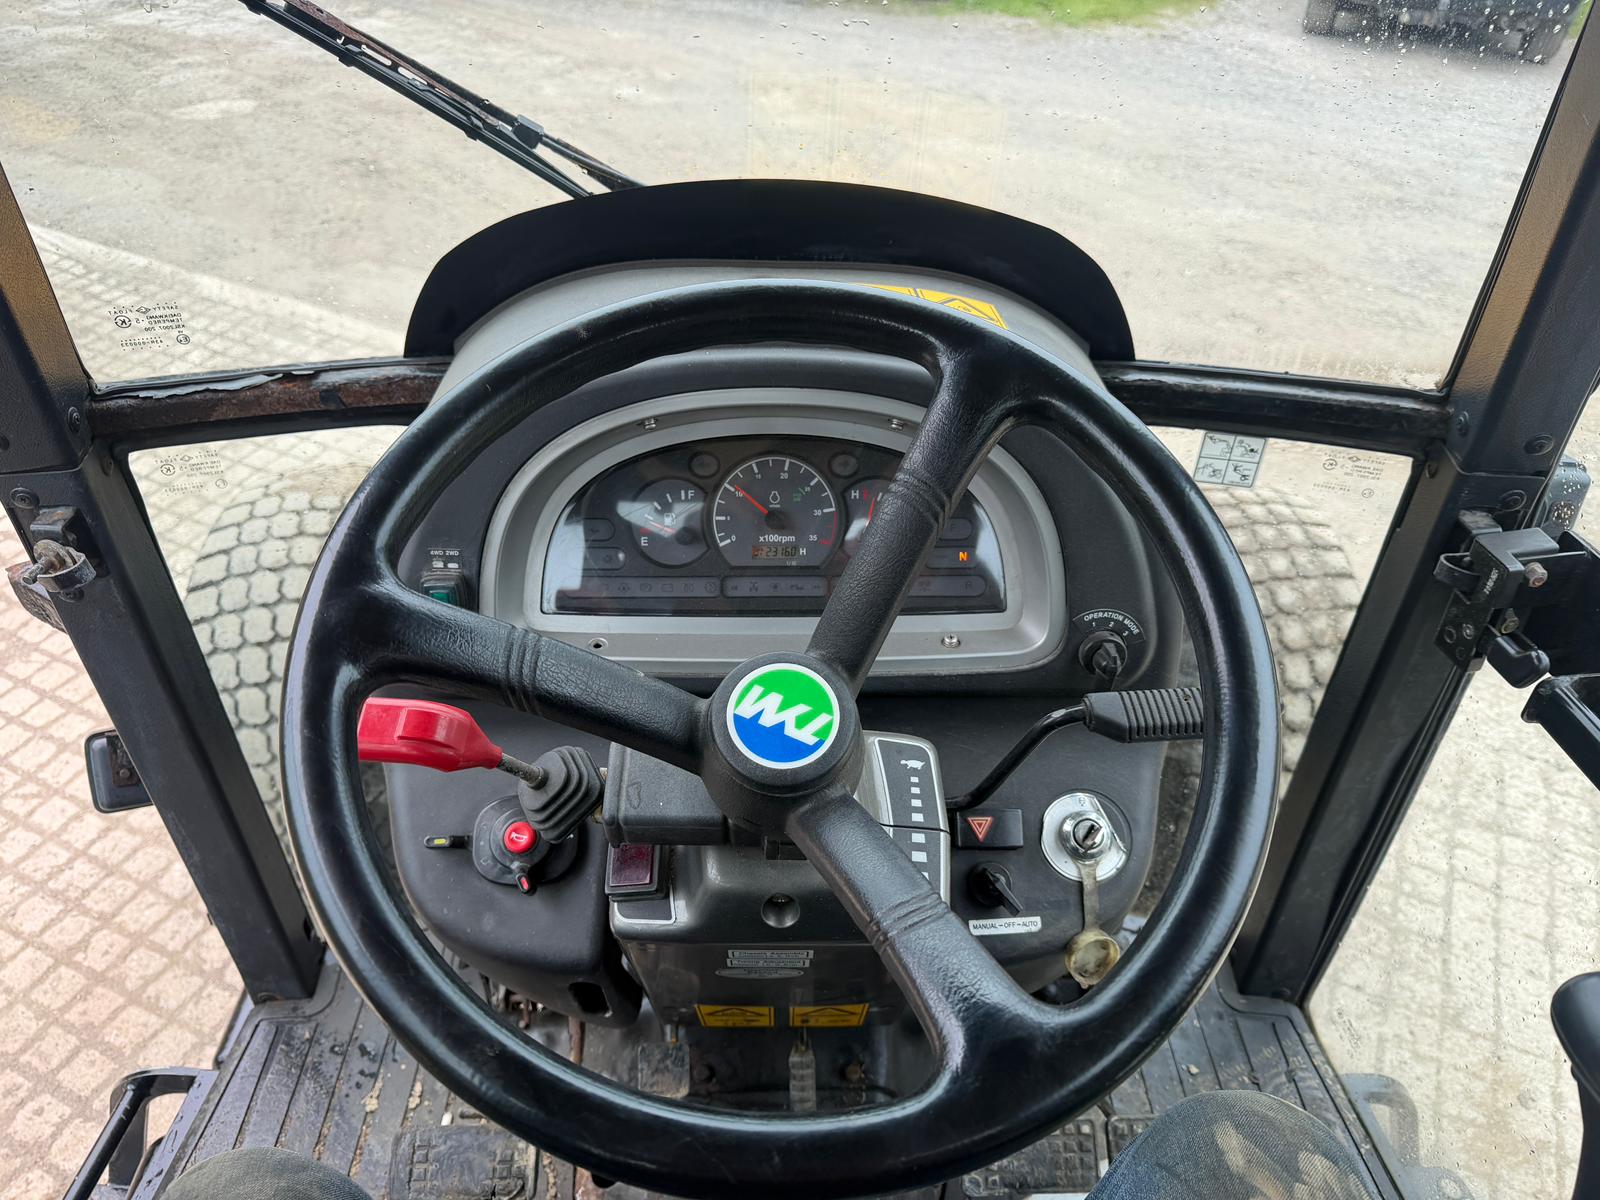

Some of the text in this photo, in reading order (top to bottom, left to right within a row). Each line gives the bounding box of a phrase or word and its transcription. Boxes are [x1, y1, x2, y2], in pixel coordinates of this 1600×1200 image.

[688, 490, 695, 499] F
[851, 490, 859, 499] H
[641, 537, 648, 546] E
[758, 534, 796, 543] x100rpm
[800, 548, 806, 556] H
[959, 552, 968, 561] N
[1084, 611, 1140, 635] OPERATION MODE
